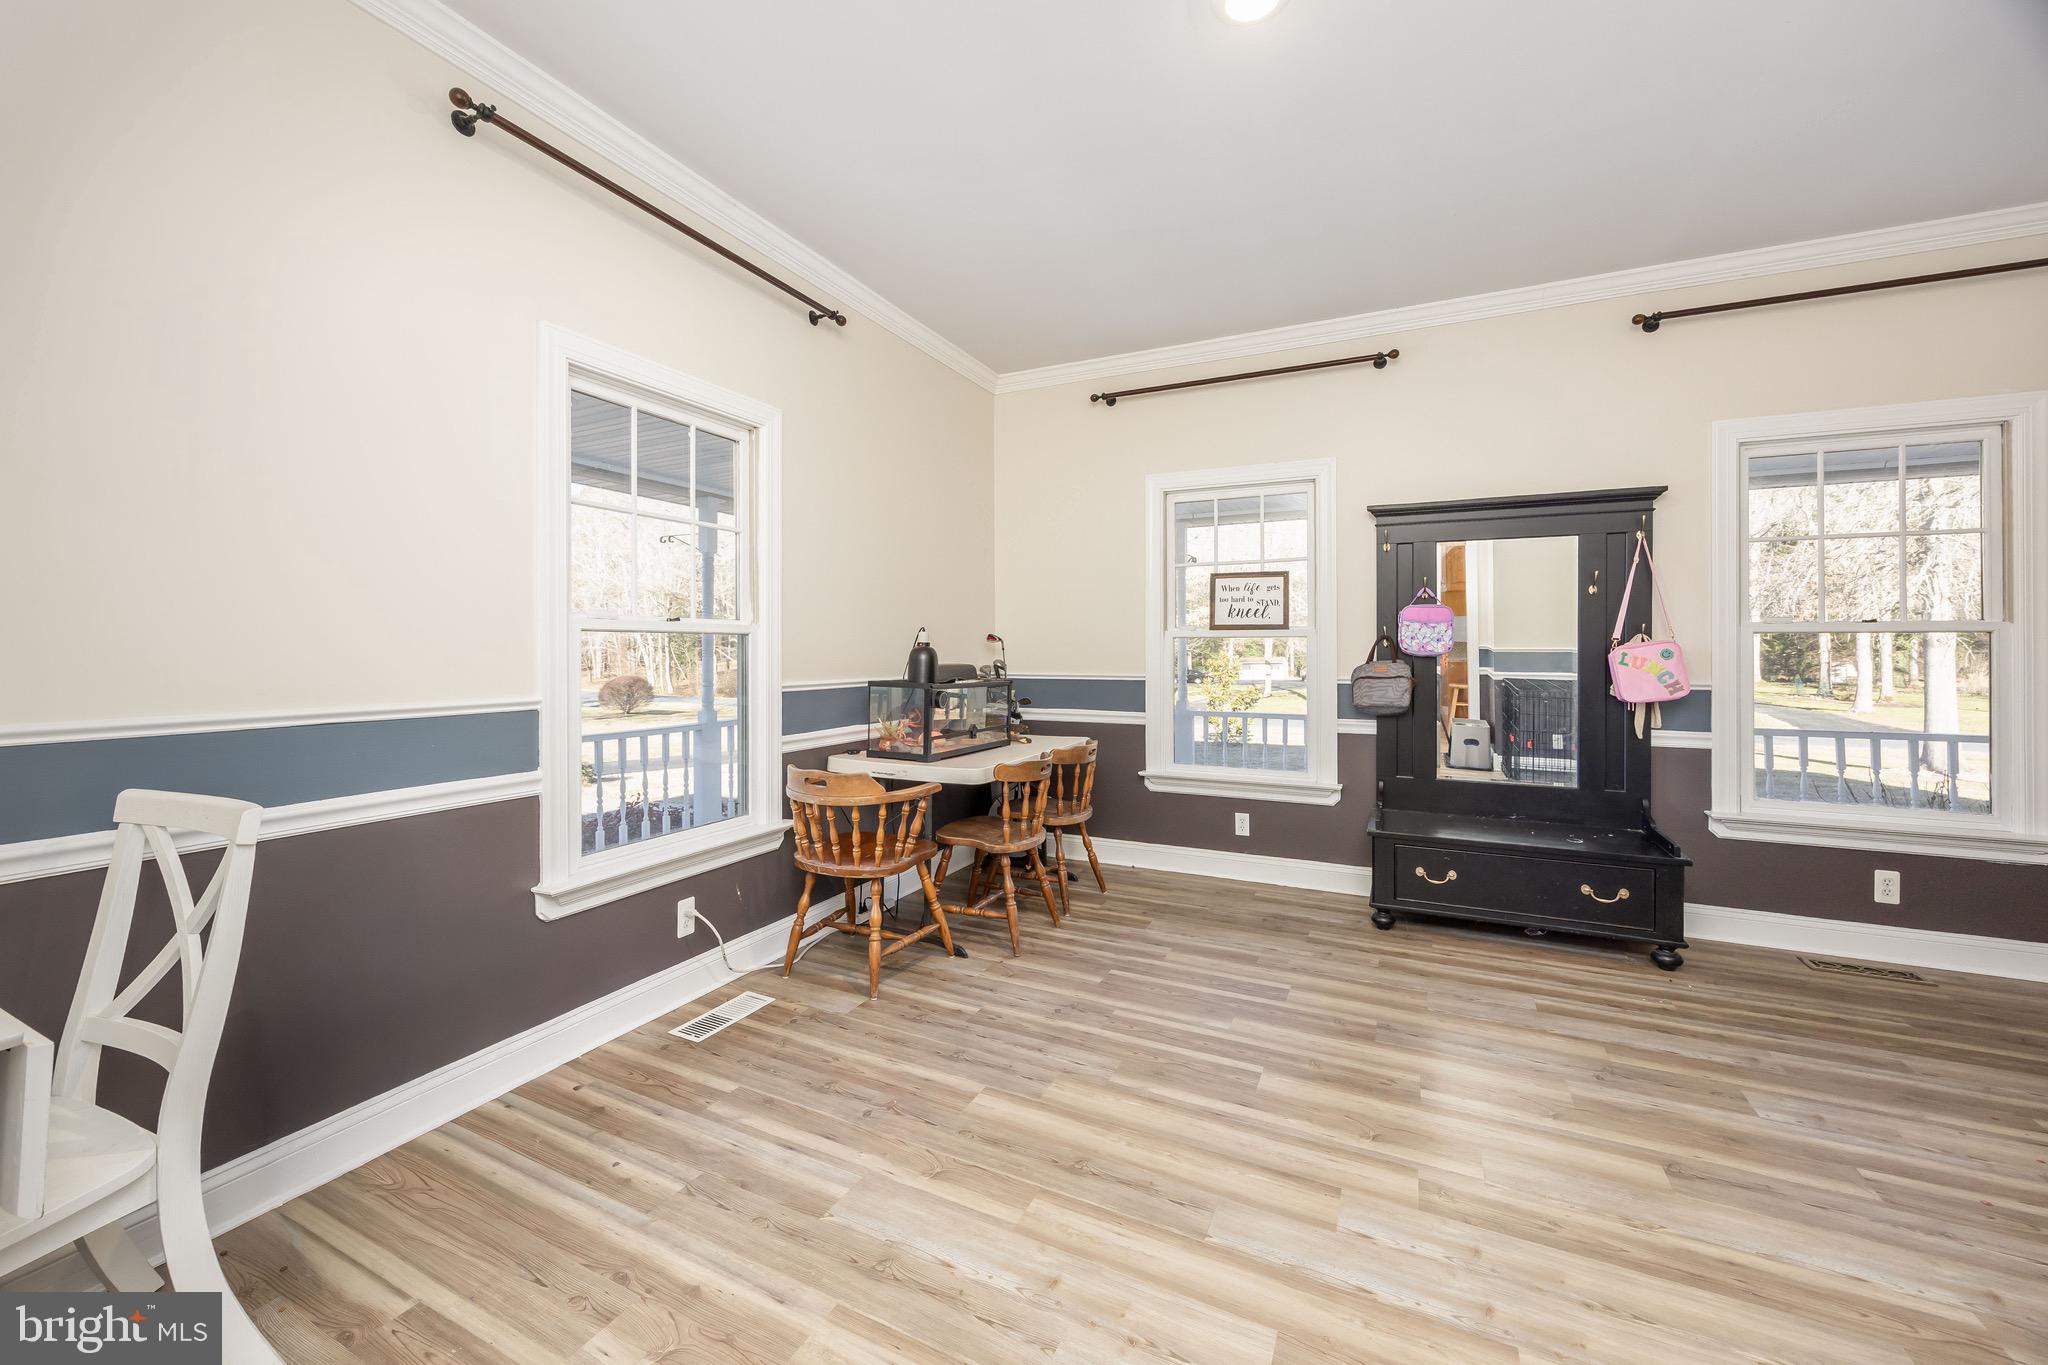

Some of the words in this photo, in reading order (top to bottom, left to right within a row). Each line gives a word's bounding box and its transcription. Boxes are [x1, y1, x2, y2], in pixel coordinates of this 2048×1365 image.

[1221, 584, 1240, 592] When
[1243, 582, 1261, 595] life
[1227, 603, 1271, 619] kneel.
[1618, 651, 1685, 696] LUNCH
